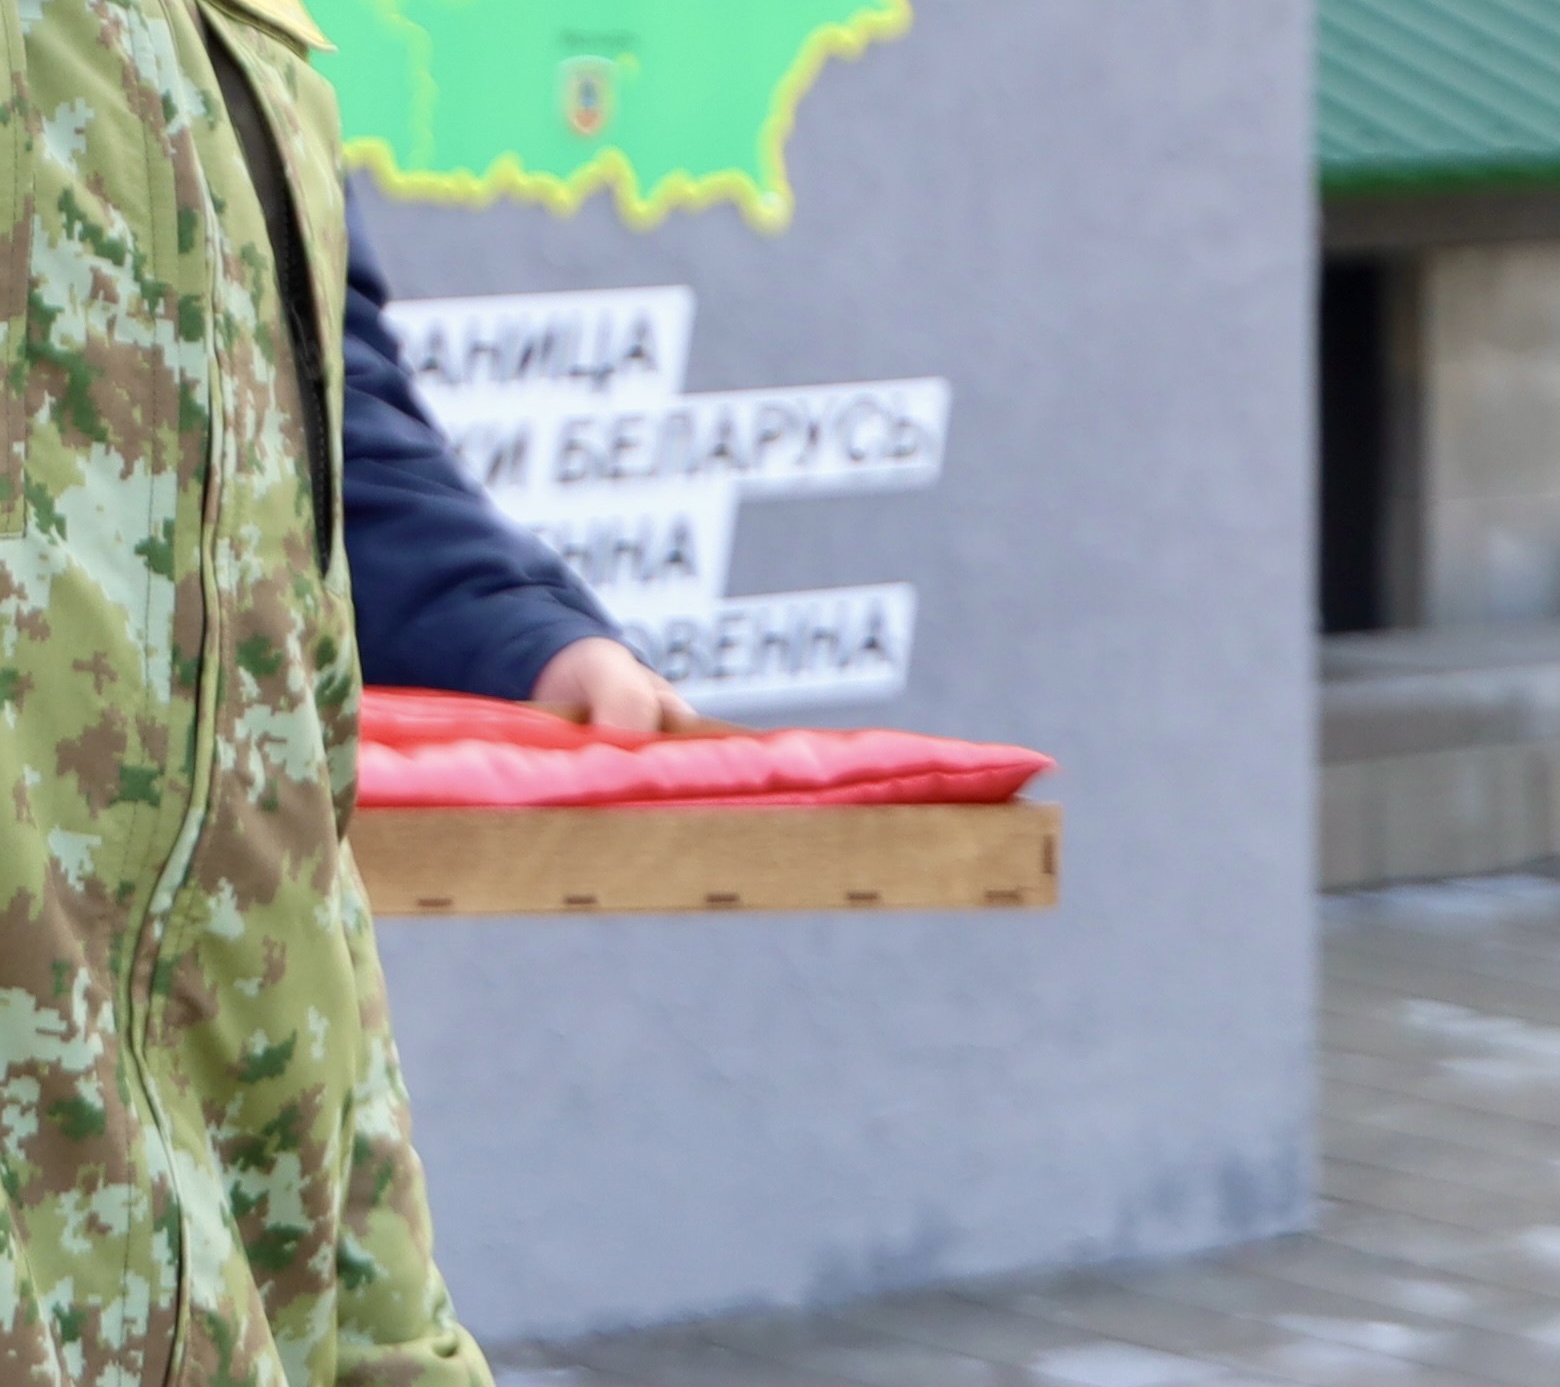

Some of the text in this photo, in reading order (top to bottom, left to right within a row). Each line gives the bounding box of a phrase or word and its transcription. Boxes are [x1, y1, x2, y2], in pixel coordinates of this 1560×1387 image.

[398, 309, 660, 393] АНИЦА
[553, 391, 931, 484] БЕЛАРУСЬ
[535, 511, 700, 587] ННА
